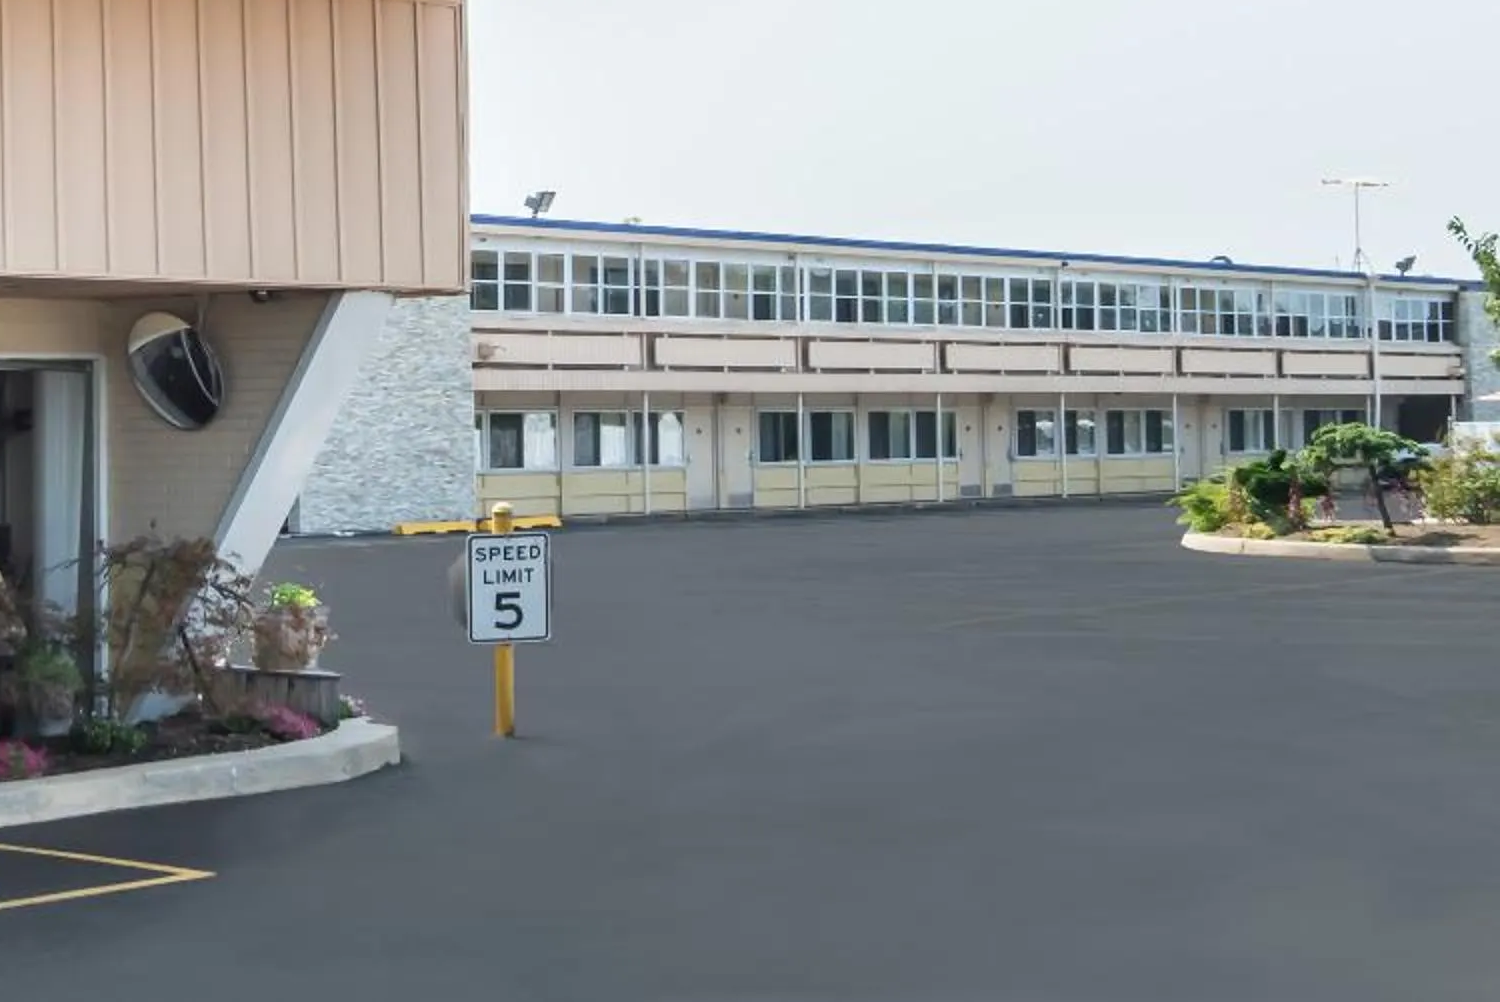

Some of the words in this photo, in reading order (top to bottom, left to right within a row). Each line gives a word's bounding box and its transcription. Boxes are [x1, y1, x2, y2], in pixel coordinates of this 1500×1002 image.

[475, 545, 541, 562] SPEED
[483, 568, 534, 585] LIMIT
[495, 592, 523, 630] 5
